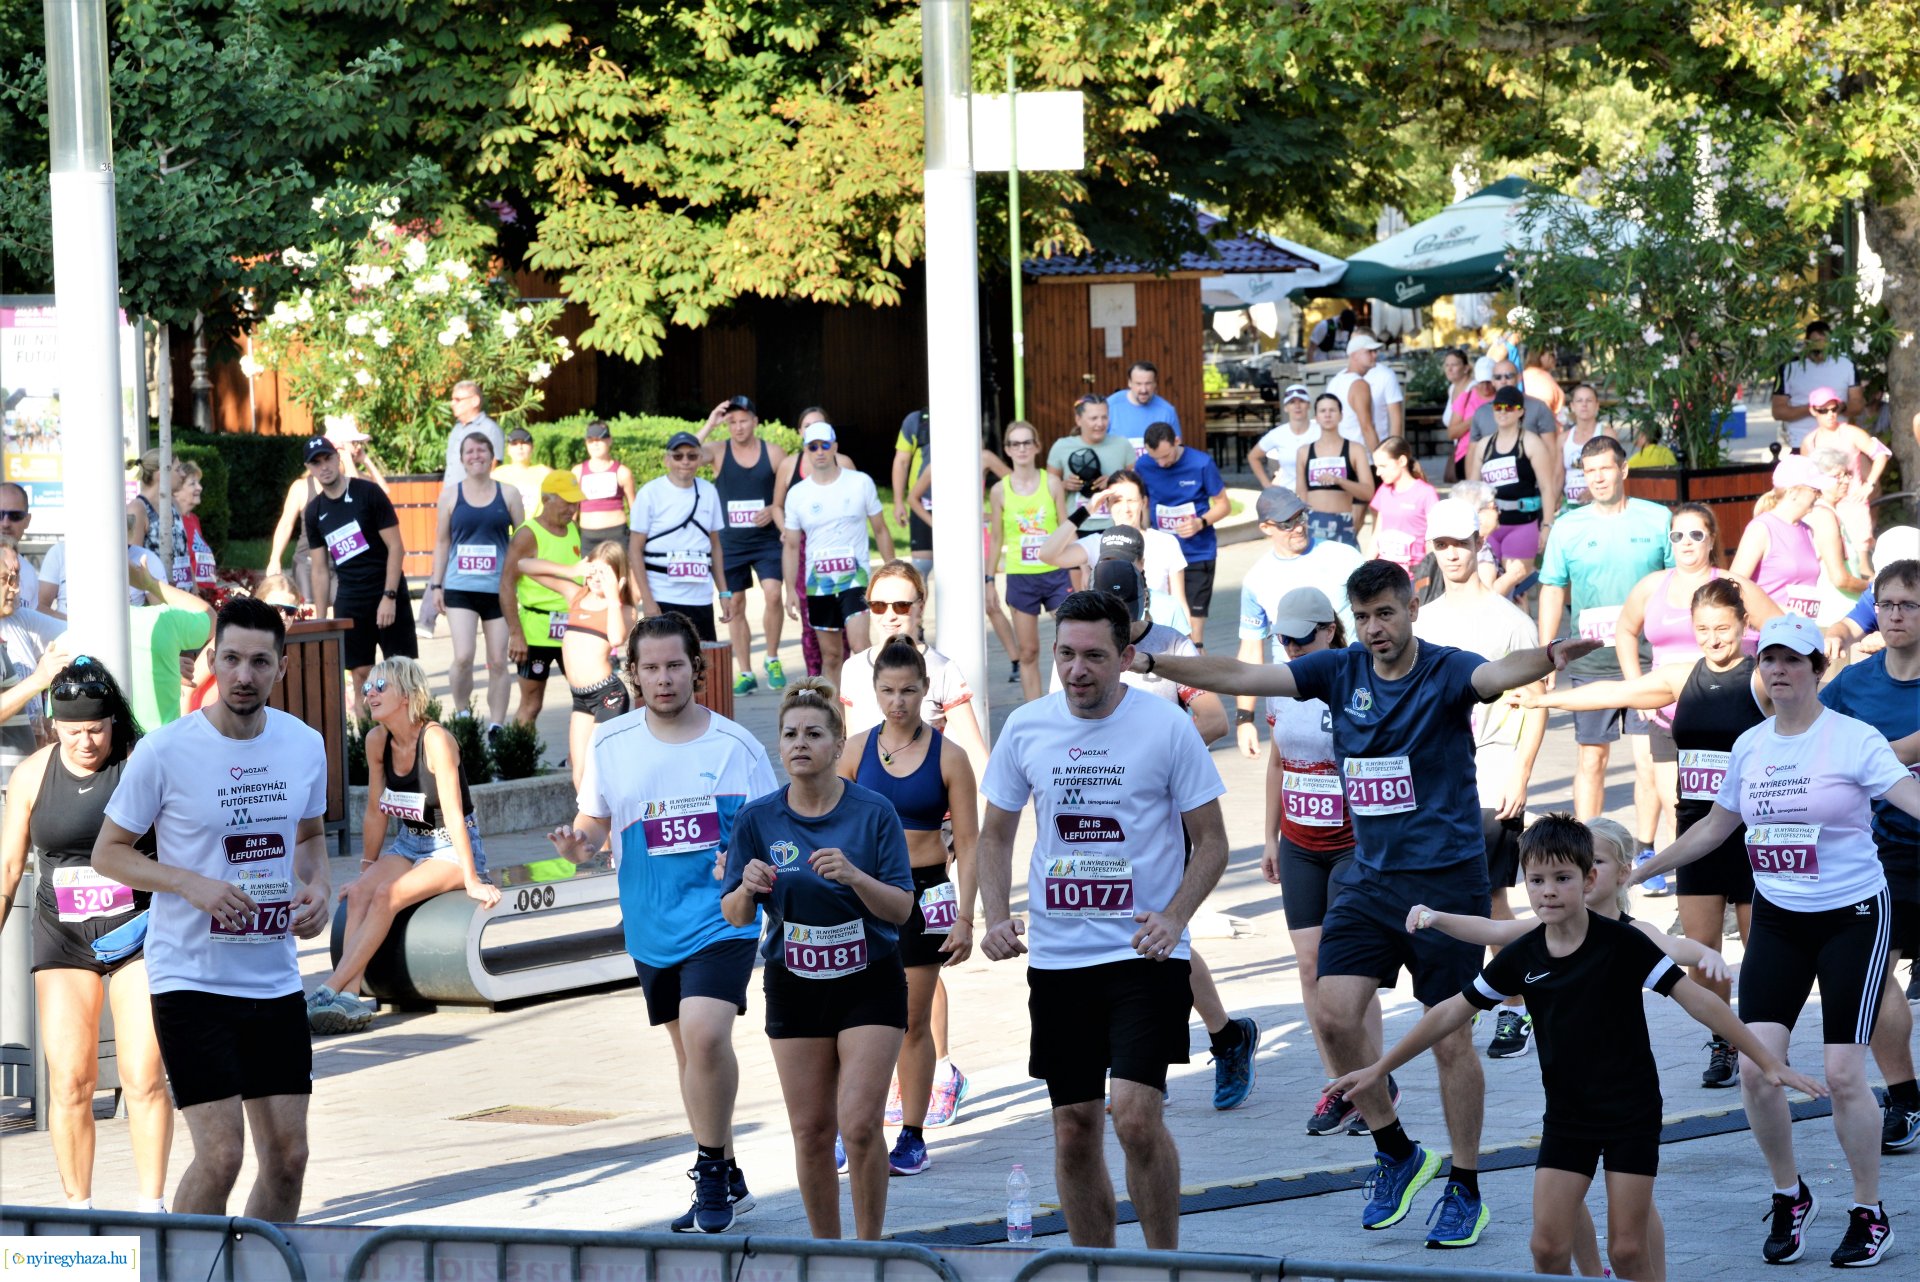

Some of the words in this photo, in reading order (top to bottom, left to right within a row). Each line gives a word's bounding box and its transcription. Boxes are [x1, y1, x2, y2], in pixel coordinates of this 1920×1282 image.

[1483, 468, 1517, 483] 10085
[335, 536, 358, 556] 505
[461, 558, 492, 569] 5150
[668, 563, 708, 576] 21100
[815, 557, 855, 573] 21119
[1052, 767, 1063, 775] III.
[1065, 764, 1126, 775] NYÍREGYHÁZI
[217, 788, 229, 797] III.
[230, 780, 287, 795] NYÍREGYHÁZI
[1053, 775, 1123, 787] FUTÓFESZTIVÁL
[1749, 782, 1758, 790] III.
[1759, 776, 1812, 789] NYÍREGYHÁZI
[1348, 779, 1411, 803] 21180
[1749, 786, 1808, 800] FUTÓFESZTIVÁL
[221, 792, 288, 808] FUTÓFESZTIVÁL
[1288, 795, 1334, 816] 5198
[661, 817, 701, 842] 556
[1078, 818, 1091, 829] ÉN
[1092, 820, 1101, 828] IS
[245, 837, 258, 848] ÉN
[259, 837, 268, 846] IS
[1064, 831, 1120, 841] LEFUTOTTAM
[231, 846, 284, 861] LEFUTOTTAM
[1756, 848, 1808, 870] 5197
[73, 887, 114, 911] 520
[1049, 882, 1130, 907] 10177
[218, 906, 288, 931] 0176
[788, 944, 862, 969] 10181
